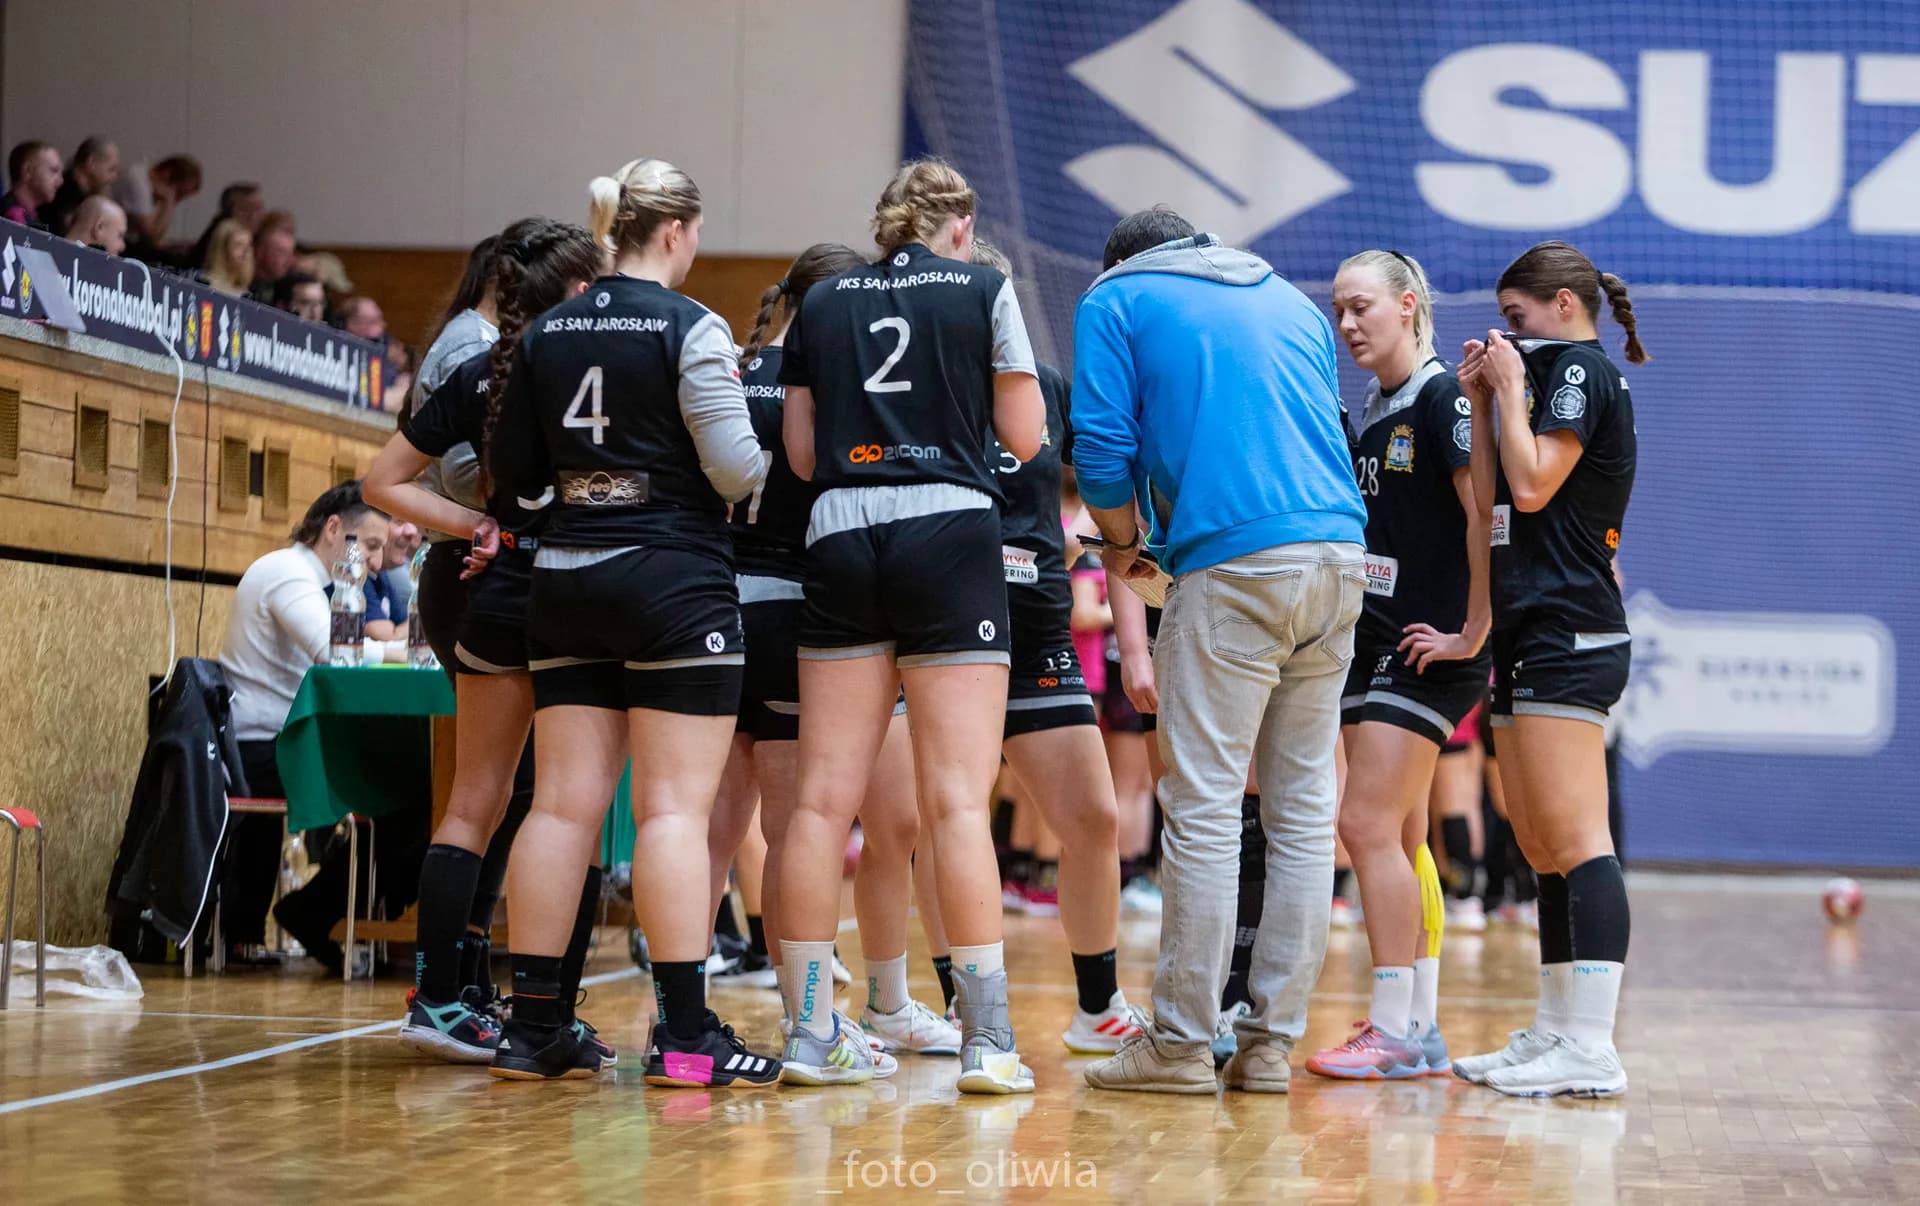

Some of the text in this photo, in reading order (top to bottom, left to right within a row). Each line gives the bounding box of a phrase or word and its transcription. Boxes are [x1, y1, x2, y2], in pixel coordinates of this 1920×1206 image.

[835, 271, 972, 291] JKS SAN JAROSŁAW
[542, 317, 669, 333] JKS SAN JAROSŁAW
[863, 316, 912, 393] 2
[475, 378, 490, 394] JK
[562, 366, 611, 445] 4
[1358, 455, 1380, 497] 28
[1003, 553, 1029, 566] YLYA
[1004, 568, 1034, 580] ERING
[1364, 561, 1393, 578] YLYA
[1368, 579, 1391, 592] RING
[1044, 651, 1072, 672] 13
[799, 960, 821, 1022] Kempa
